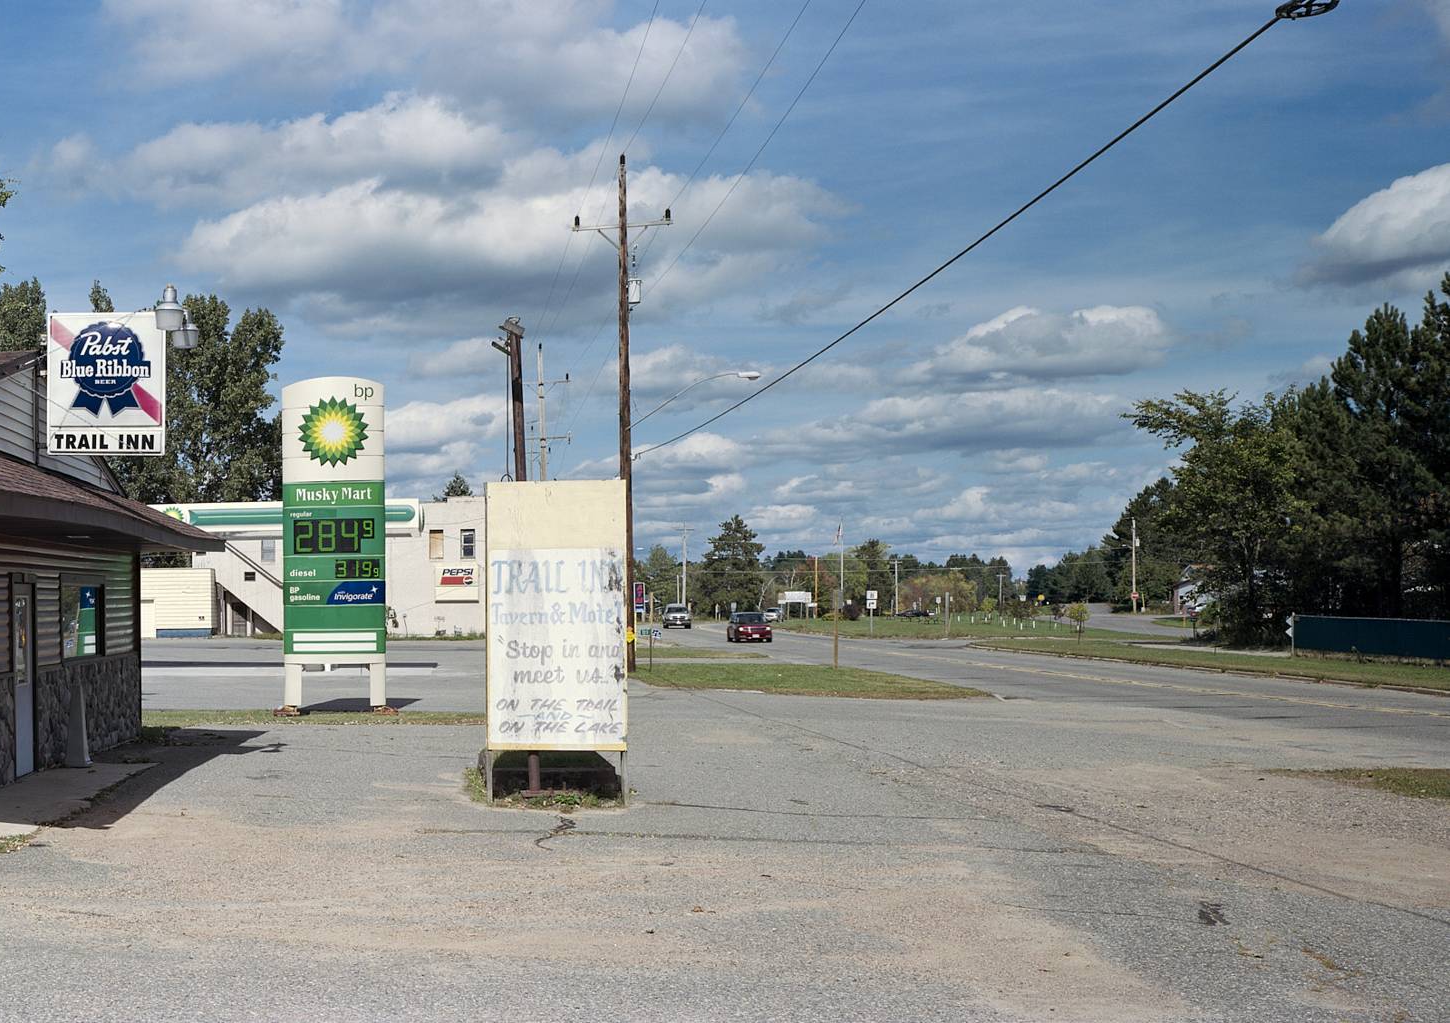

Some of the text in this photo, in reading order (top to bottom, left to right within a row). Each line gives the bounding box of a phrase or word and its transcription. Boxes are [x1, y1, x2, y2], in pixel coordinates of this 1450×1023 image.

[80, 331, 133, 356] Pabst
[61, 358, 150, 378] Blue Ribbon
[354, 384, 374, 400] bp
[54, 433, 155, 450] TRAIL INN
[296, 486, 372, 504] Musky Mart
[289, 511, 313, 519] regular
[289, 568, 317, 577] diesel
[442, 568, 473, 576] PEPSI
[491, 560, 567, 594] TRAIL
[289, 586, 300, 594] BP
[289, 593, 321, 602] gasoline
[491, 600, 622, 625] Tavern & Motel
[562, 639, 579, 659] in
[513, 666, 565, 684] meet
[496, 698, 619, 712] ON THE TRAIL
[499, 720, 623, 734] ON THE LAKE
